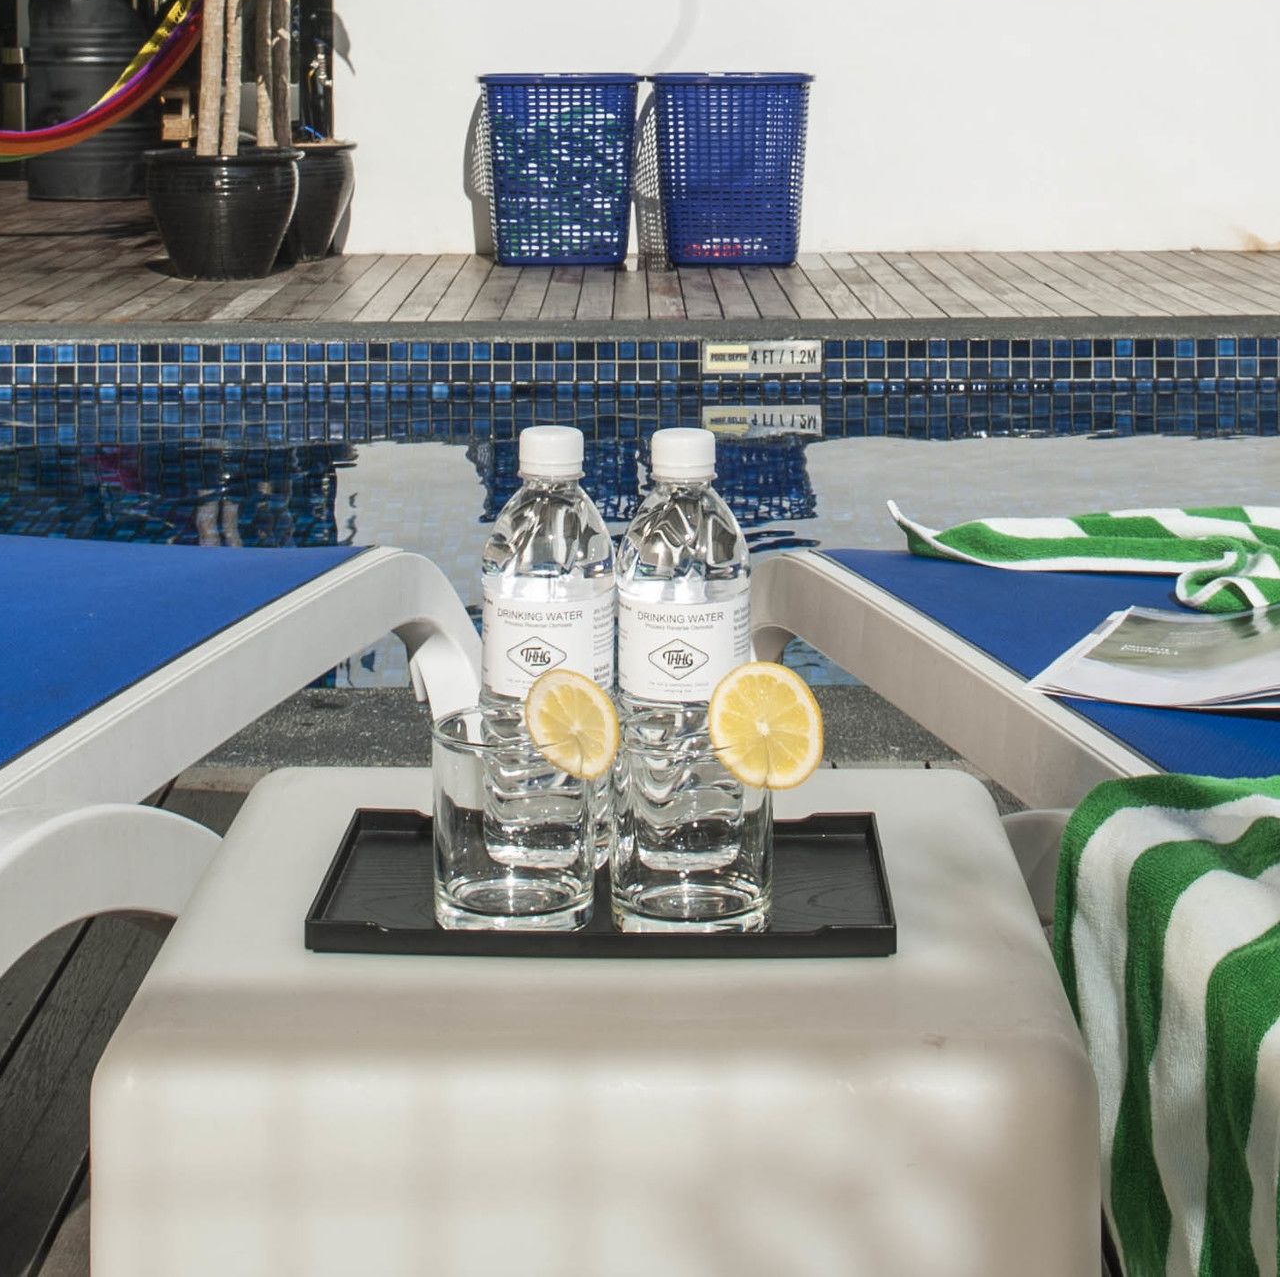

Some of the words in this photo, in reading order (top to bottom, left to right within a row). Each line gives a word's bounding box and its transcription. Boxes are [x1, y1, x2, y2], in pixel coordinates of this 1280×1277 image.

[751, 350, 758, 364] 4
[763, 350, 775, 364] FT
[790, 350, 816, 364] 1.2M
[498, 608, 543, 621] DRINKING
[546, 611, 583, 620] WATER
[638, 612, 685, 623] DRINKING
[687, 612, 724, 622] WATER
